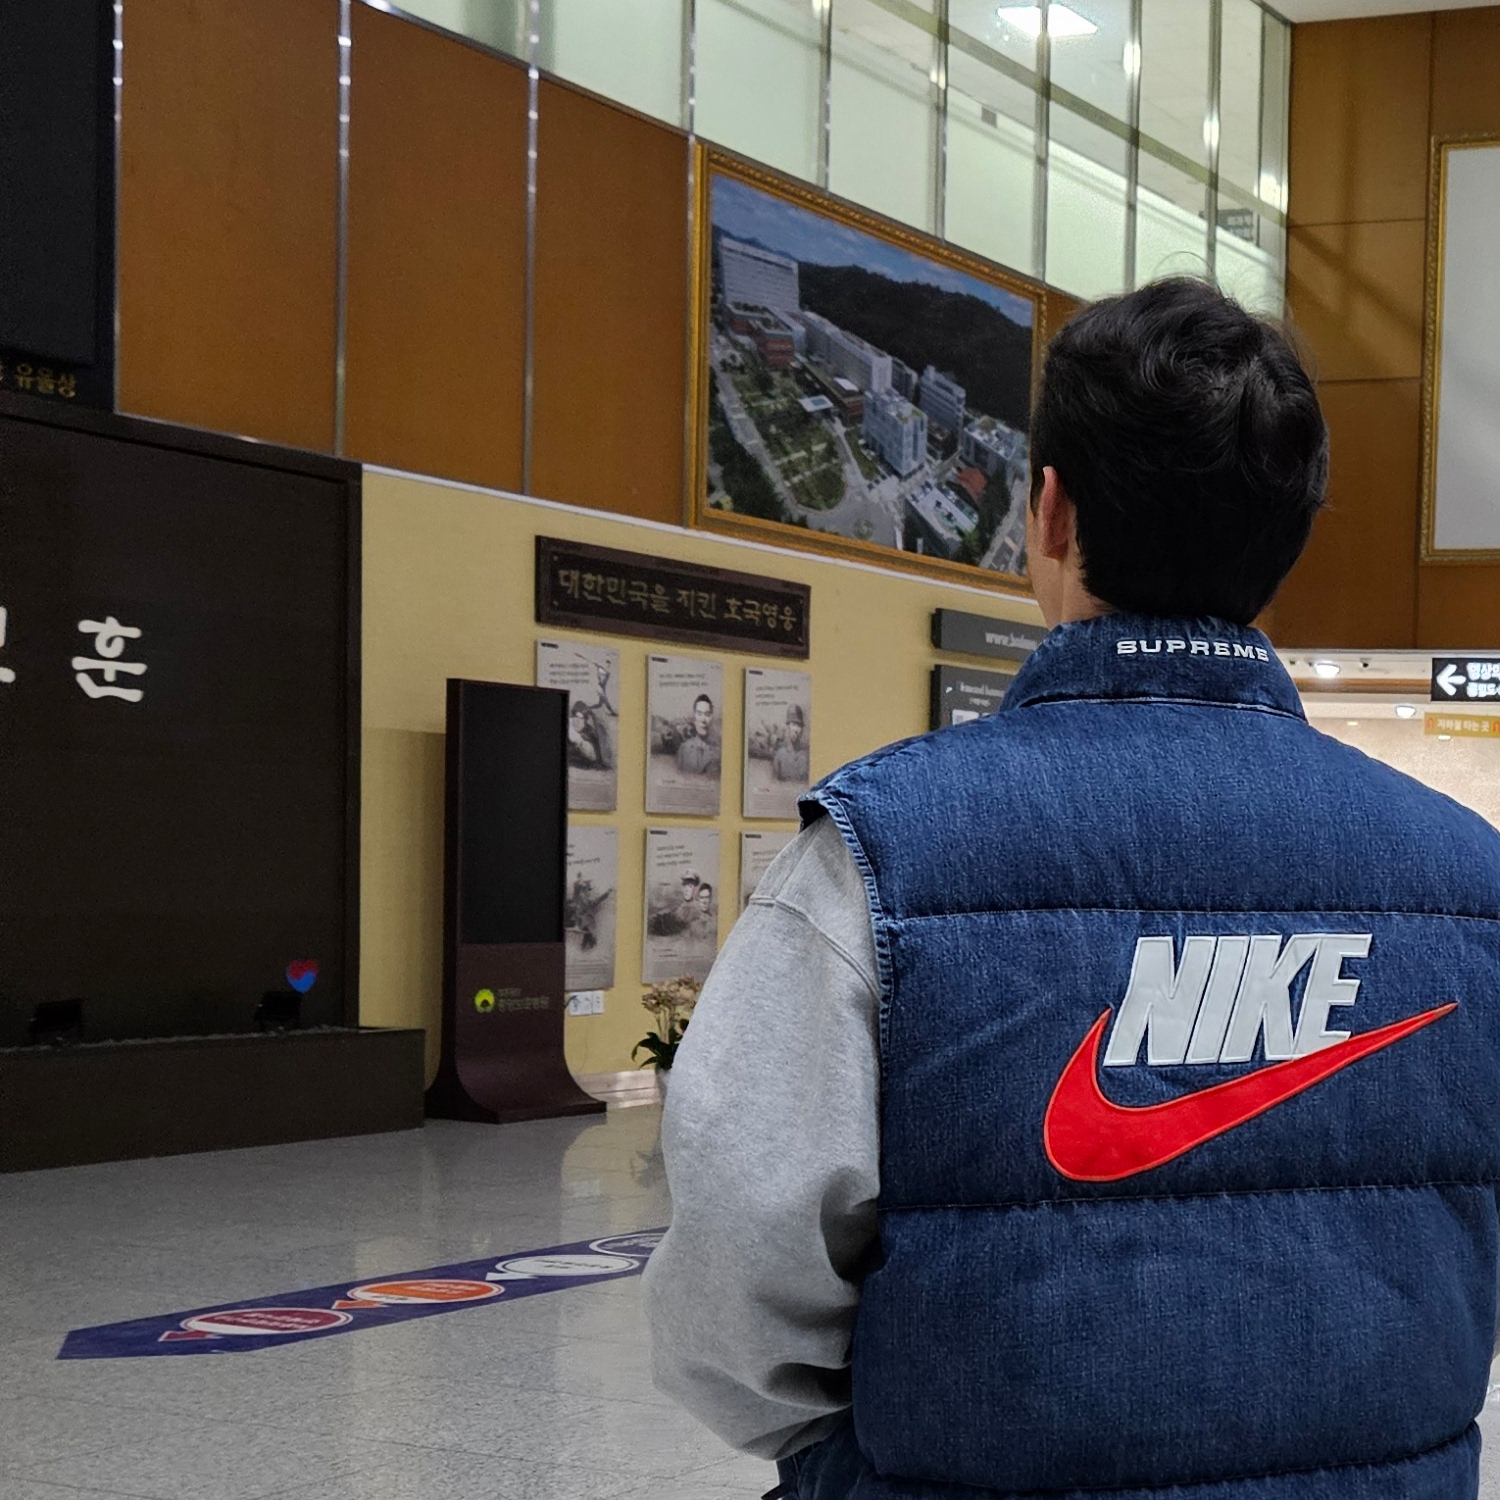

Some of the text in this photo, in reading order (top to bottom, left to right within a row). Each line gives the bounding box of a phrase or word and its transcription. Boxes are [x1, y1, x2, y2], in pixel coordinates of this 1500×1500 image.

[558, 568, 798, 631] 대한민국을 지킨 호국영웅
[71, 615, 148, 703] 훈
[1115, 638, 1270, 663] SUPREME
[1102, 933, 1374, 1067] NIKE
